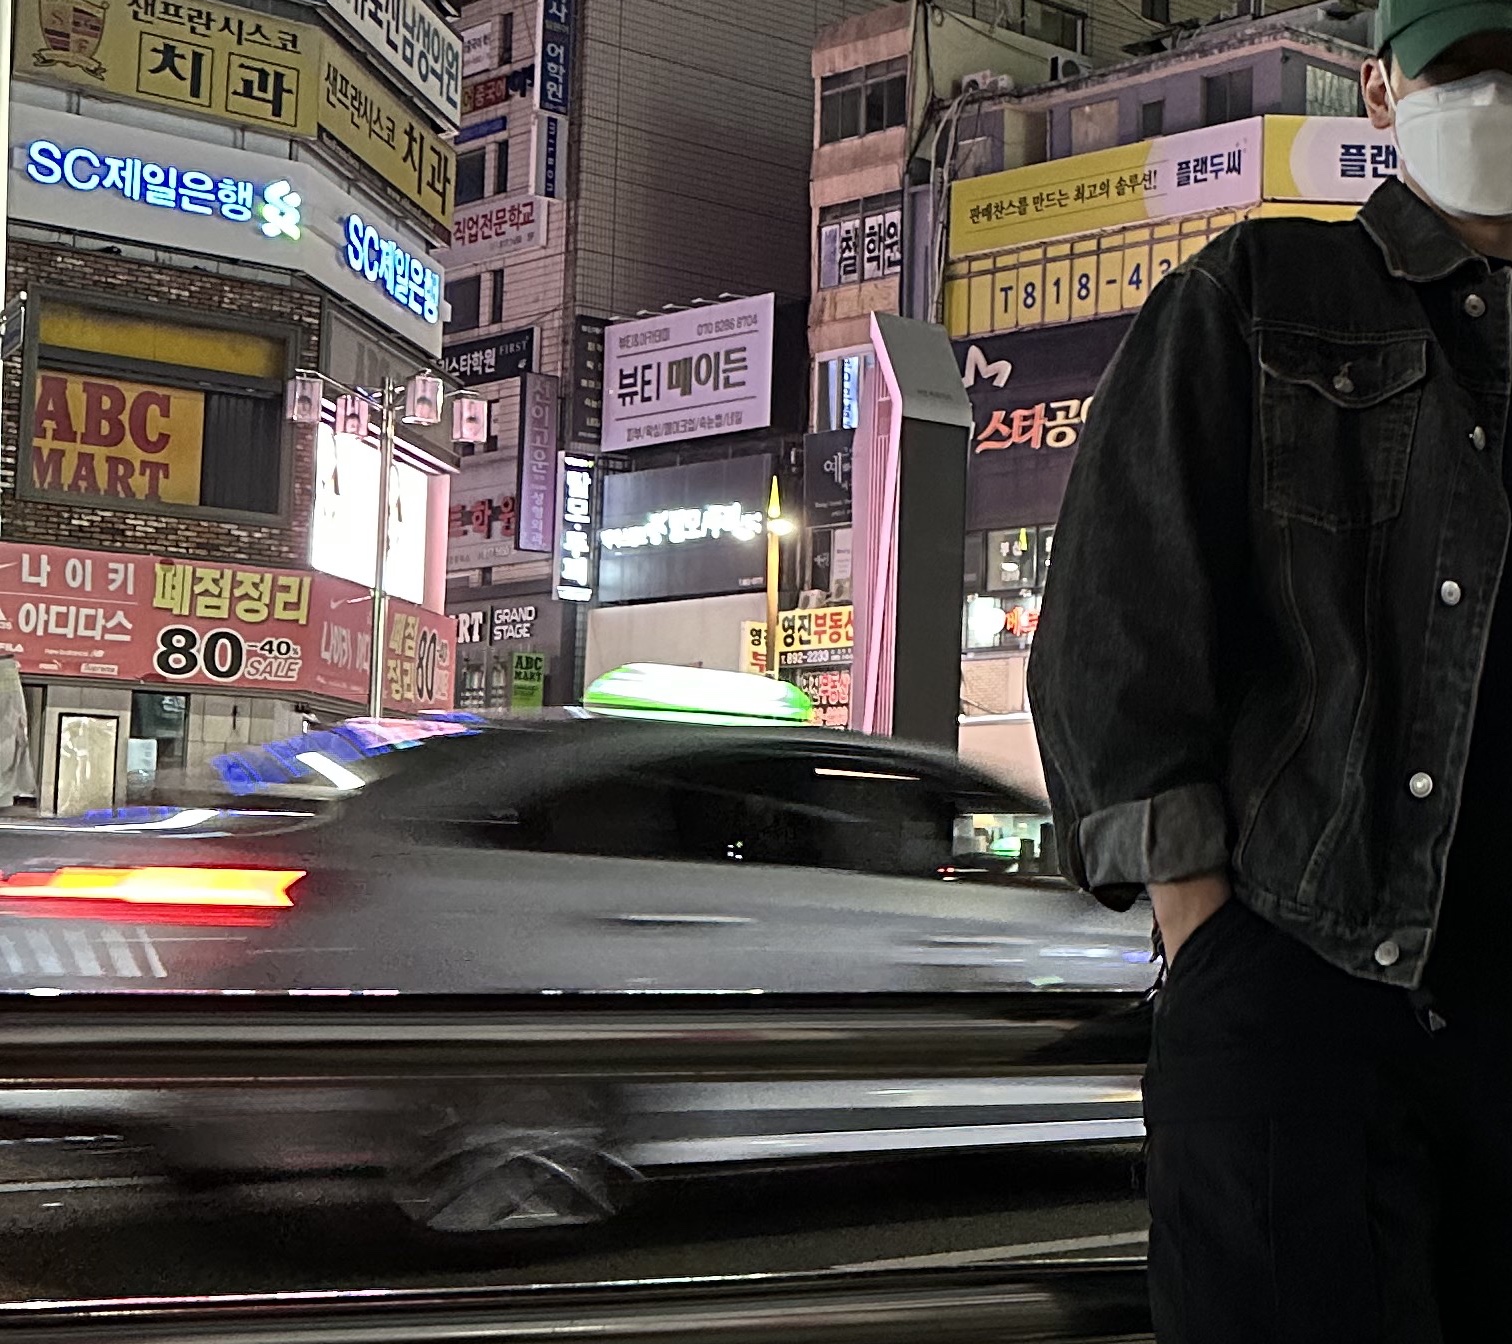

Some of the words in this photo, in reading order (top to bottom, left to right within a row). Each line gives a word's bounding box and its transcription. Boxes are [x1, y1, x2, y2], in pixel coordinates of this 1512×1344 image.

[325, 62, 396, 150] 샌프란시스코
[404, 124, 452, 217] 치과
[27, 139, 254, 223] SC제일은행
[1175, 149, 1242, 188] 플랜두씨
[1032, 187, 1071, 213] 만드는
[1074, 178, 1110, 204] 최고의
[346, 213, 441, 325] SC제일은행
[500, 341, 528, 355] FIRST
[618, 362, 661, 406] 뷰티
[667, 346, 748, 397] 메이든
[34, 374, 172, 454] ABC
[31, 446, 170, 502] MART
[21, 553, 135, 595] 나이키
[152, 561, 312, 626] 폐점정리
[18, 602, 133, 642] 아디다스
[493, 623, 532, 641] STAGE
[494, 606, 536, 623] GRAND
[153, 623, 247, 683] 80
[244, 657, 300, 681] SALE
[416, 626, 439, 704] 80
[515, 656, 543, 670] ABC
[514, 670, 542, 681] MART
